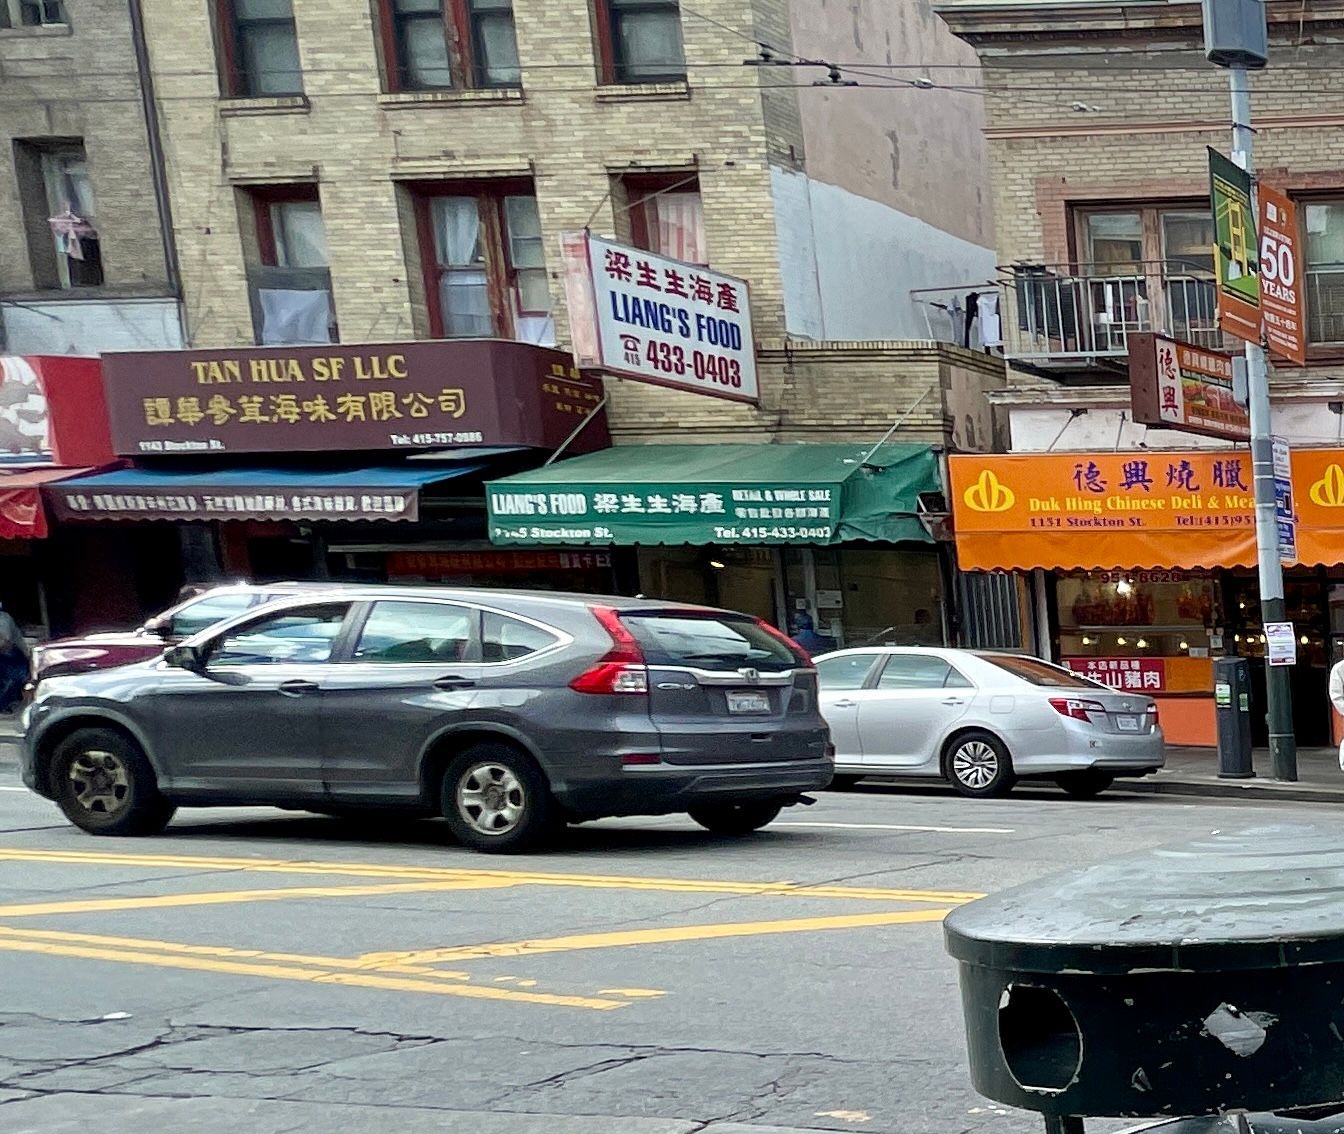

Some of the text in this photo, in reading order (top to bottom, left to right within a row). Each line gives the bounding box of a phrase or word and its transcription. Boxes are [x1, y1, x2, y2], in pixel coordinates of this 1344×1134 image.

[1261, 236, 1294, 288] 50
[604, 249, 740, 314] 梁生生海產
[1262, 278, 1296, 305] YEARS
[609, 290, 742, 351] LIANG'S FOOD
[191, 355, 408, 384] TAN HUA SF LLC
[623, 352, 641, 366] 415
[646, 340, 742, 388] 433-0403
[1073, 459, 1249, 494] 德興燒臘
[491, 493, 588, 516] LIANG'S FOOD
[593, 492, 727, 515] 梁生生海產
[1029, 496, 1220, 515] Duk Hing Chinese Deli &
[531, 527, 614, 539] Stockton St.
[714, 525, 832, 540] Tel. 415-433-0403
[1067, 517, 1125, 528] Stockton
